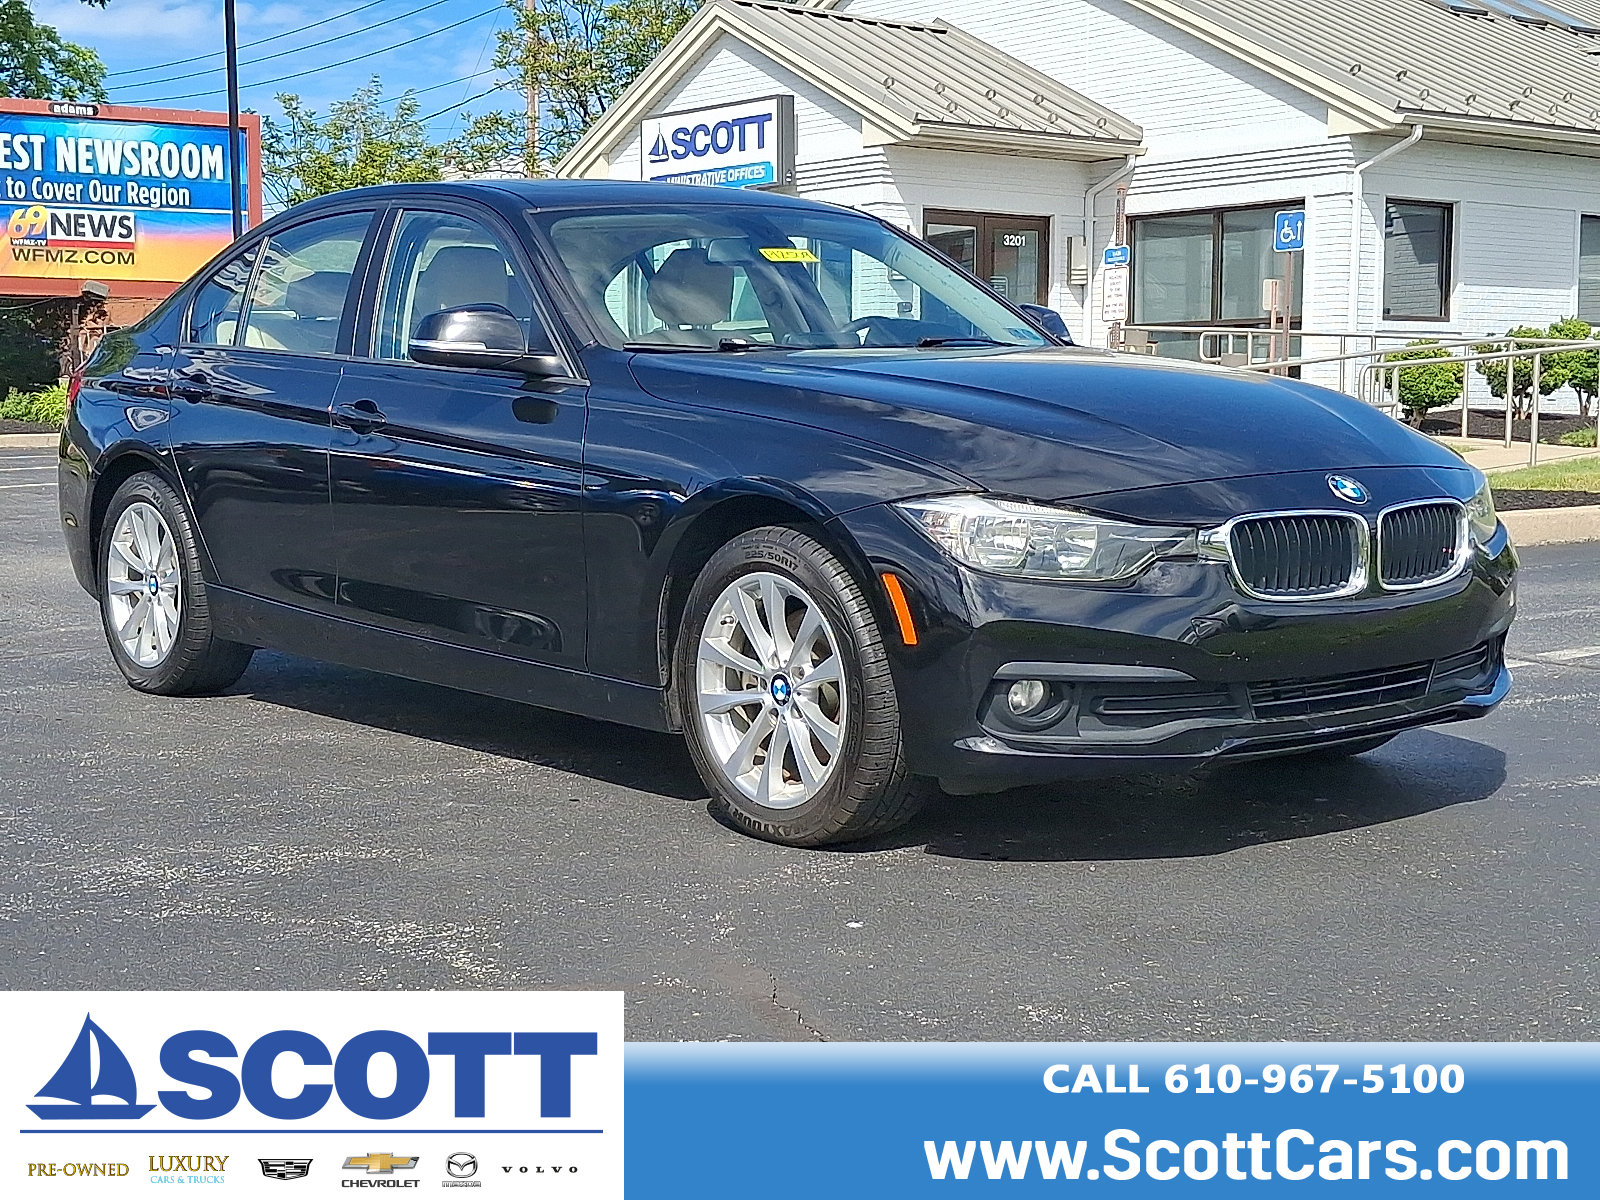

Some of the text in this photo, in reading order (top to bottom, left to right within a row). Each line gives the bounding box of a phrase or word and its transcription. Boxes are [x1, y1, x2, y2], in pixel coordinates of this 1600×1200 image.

[53, 103, 94, 116] adams
[671, 113, 772, 160] SCOTT
[0, 132, 224, 180] EST NEWSROOM
[727, 165, 766, 182] OFFICES
[6, 176, 190, 208] to Cover Our Region
[8, 204, 133, 239] 69 NEWS
[1003, 234, 1026, 247] 3201
[12, 248, 135, 265] WFMZ.COM
